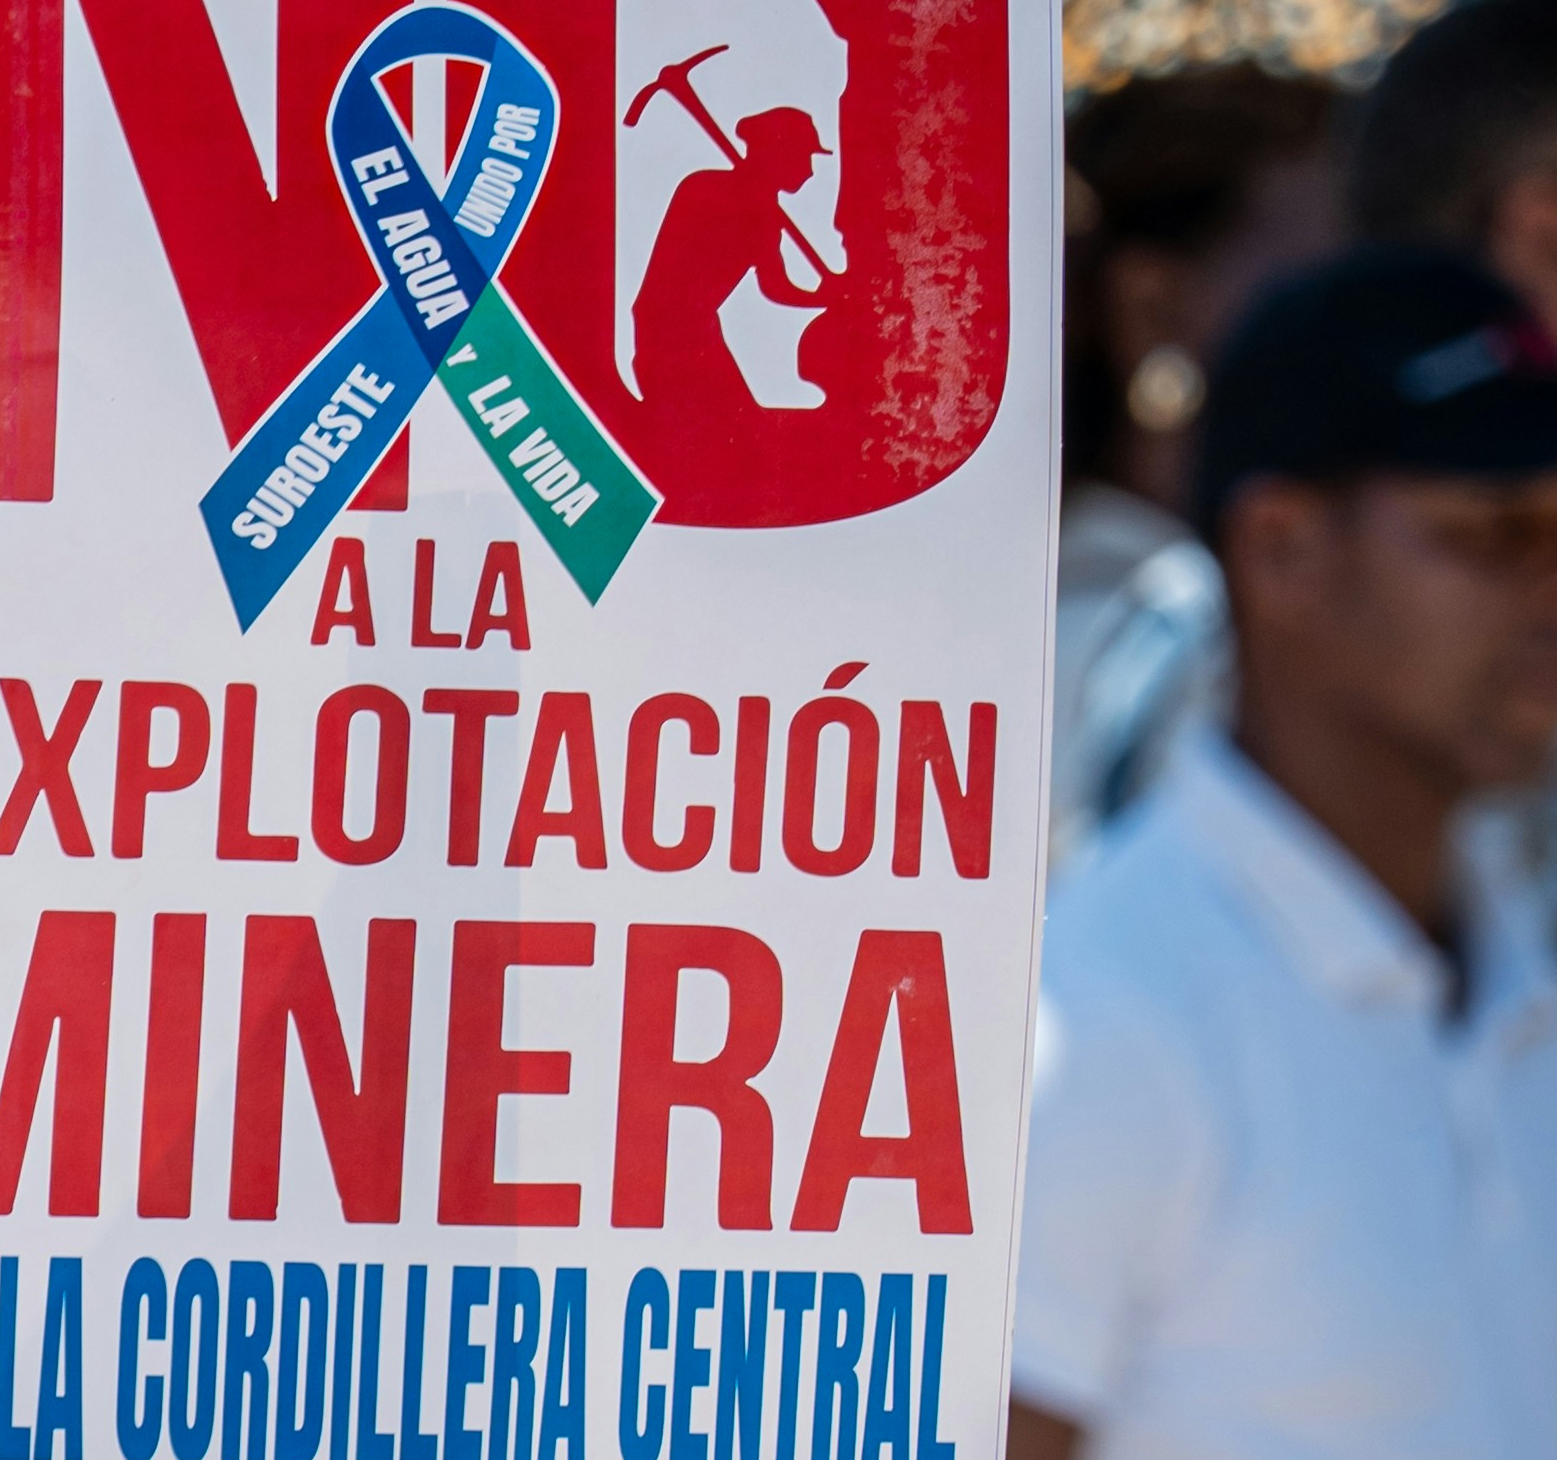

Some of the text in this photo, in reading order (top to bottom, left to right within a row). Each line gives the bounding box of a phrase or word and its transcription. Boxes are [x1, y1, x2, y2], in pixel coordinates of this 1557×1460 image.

[350, 145, 470, 330] EL AGUA
[453, 103, 541, 238] UNIDO POR
[231, 362, 396, 550] SUROESTE
[446, 343, 600, 528] Y LA VIDA
[311, 537, 531, 651] A LA
